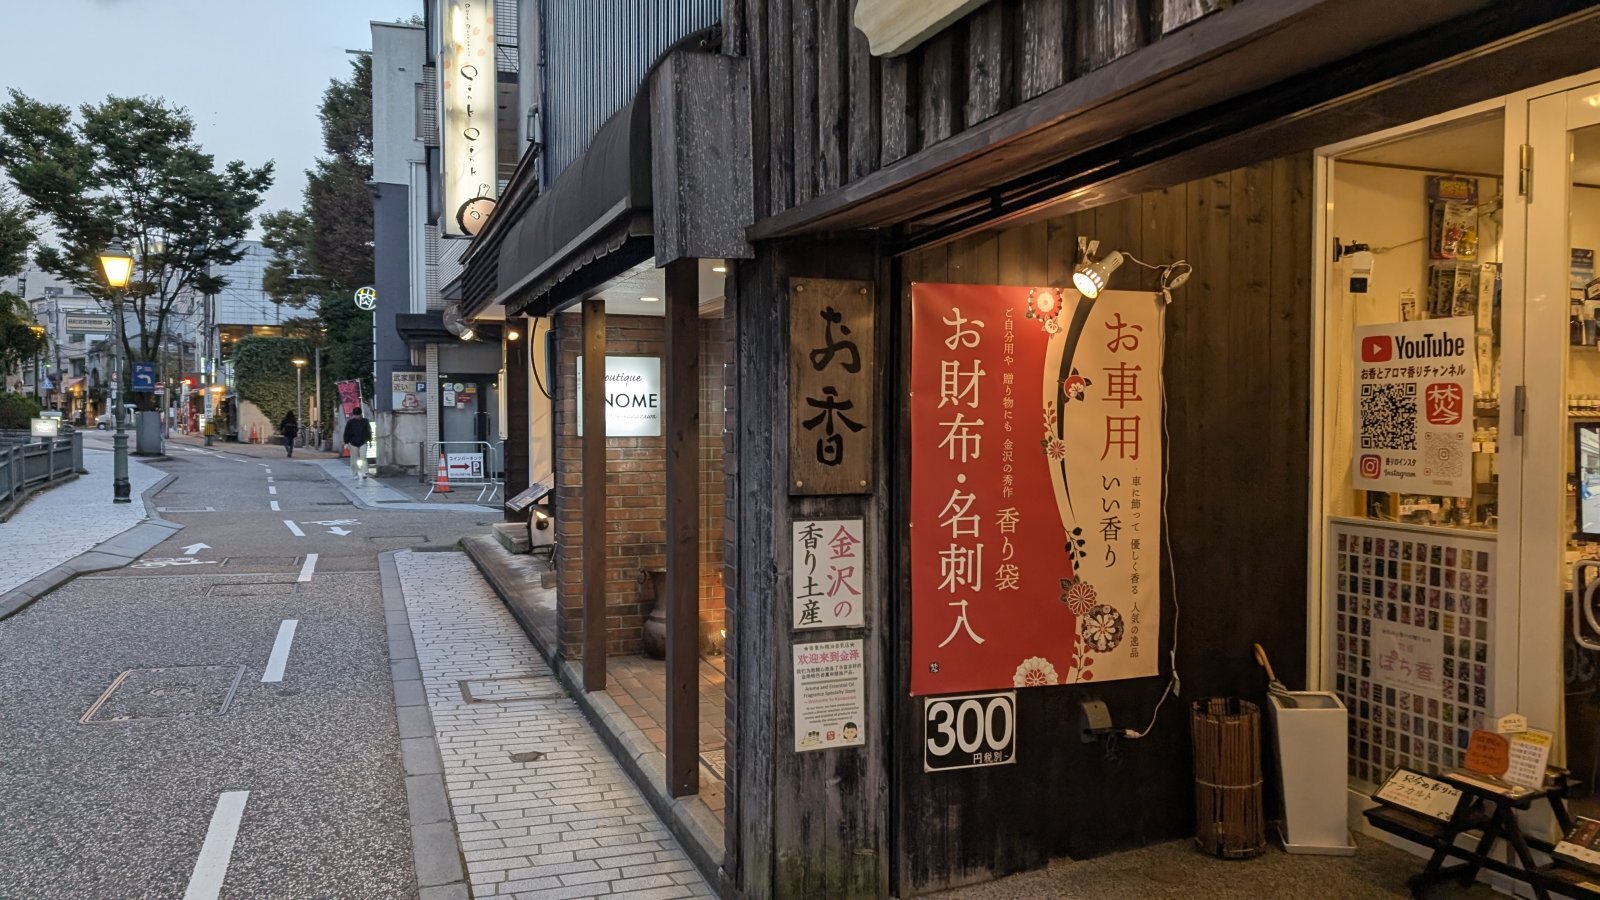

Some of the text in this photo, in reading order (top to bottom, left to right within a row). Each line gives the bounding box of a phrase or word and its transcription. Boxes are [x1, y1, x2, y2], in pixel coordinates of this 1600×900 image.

[605, 373, 642, 387] outique
[1360, 364, 1466, 380] お香とアロマ香りチャンネル
[1395, 331, 1465, 360] YouTube
[394, 383, 409, 391] 近い
[605, 393, 657, 408] NOME
[802, 306, 867, 466] お香
[1002, 307, 1015, 498] ご自分用や 贈り物にも 金沢の秀作
[1099, 312, 1143, 568] お車用 いい香り
[1384, 469, 1417, 481] Instagram
[938, 307, 986, 648] お財布・名刺入
[797, 522, 824, 626] 香り土産
[826, 525, 861, 619] 金沢の
[995, 507, 1020, 592] 香り袋
[1129, 476, 1142, 658] 車に飾って 優しく香る 人気の逸品
[797, 649, 860, 665] 欢迎来到金泽
[928, 697, 1012, 756] 300
